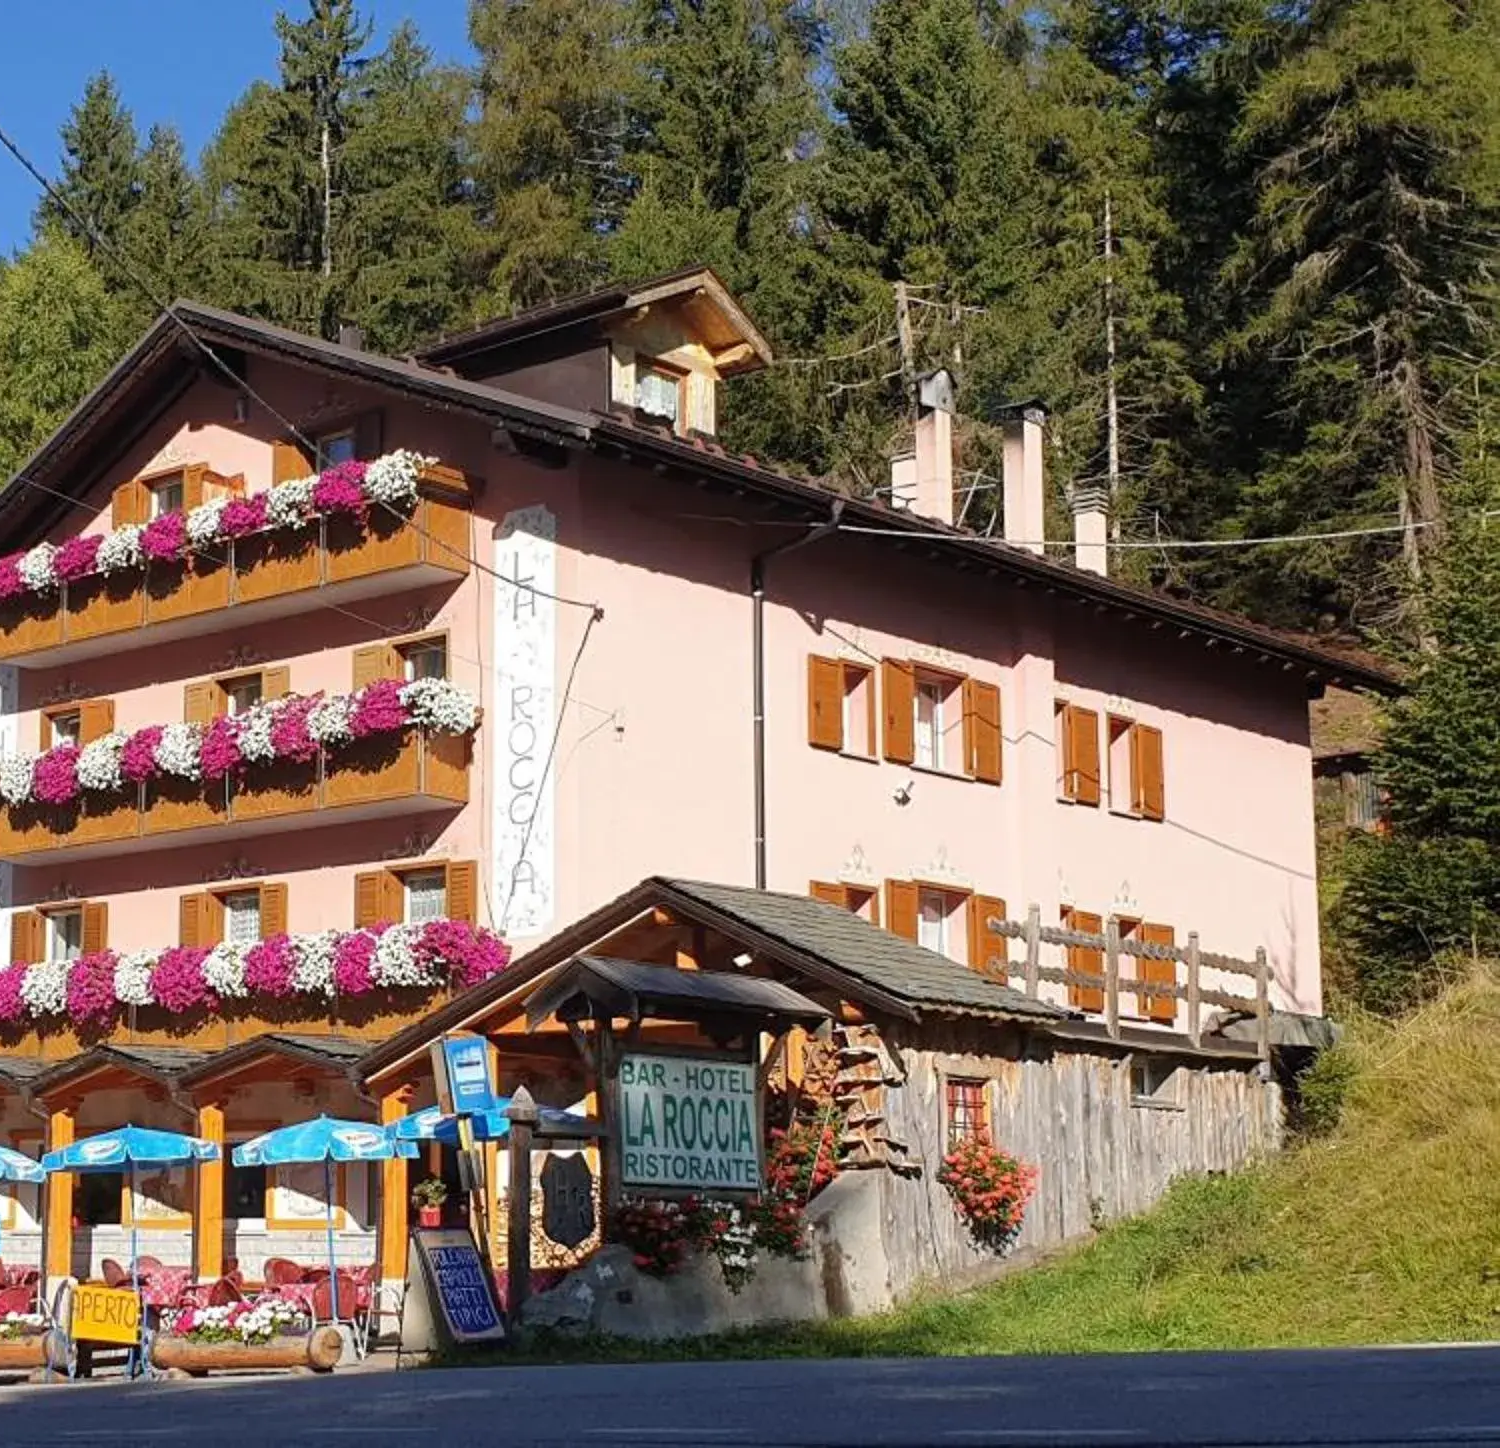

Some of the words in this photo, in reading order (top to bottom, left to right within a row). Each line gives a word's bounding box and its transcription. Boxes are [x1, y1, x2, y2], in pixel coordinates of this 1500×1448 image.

[511, 551, 536, 622] LA
[507, 686, 536, 896] ROCCIA
[621, 1060, 666, 1088] BAR
[685, 1065, 753, 1094] HOTEL
[624, 1091, 657, 1147] LA
[662, 1093, 753, 1153] ROCCIA
[625, 1153, 757, 1183] RISTORANTE
[71, 1291, 136, 1328] APERTO
[449, 1306, 493, 1326] TIPICI
